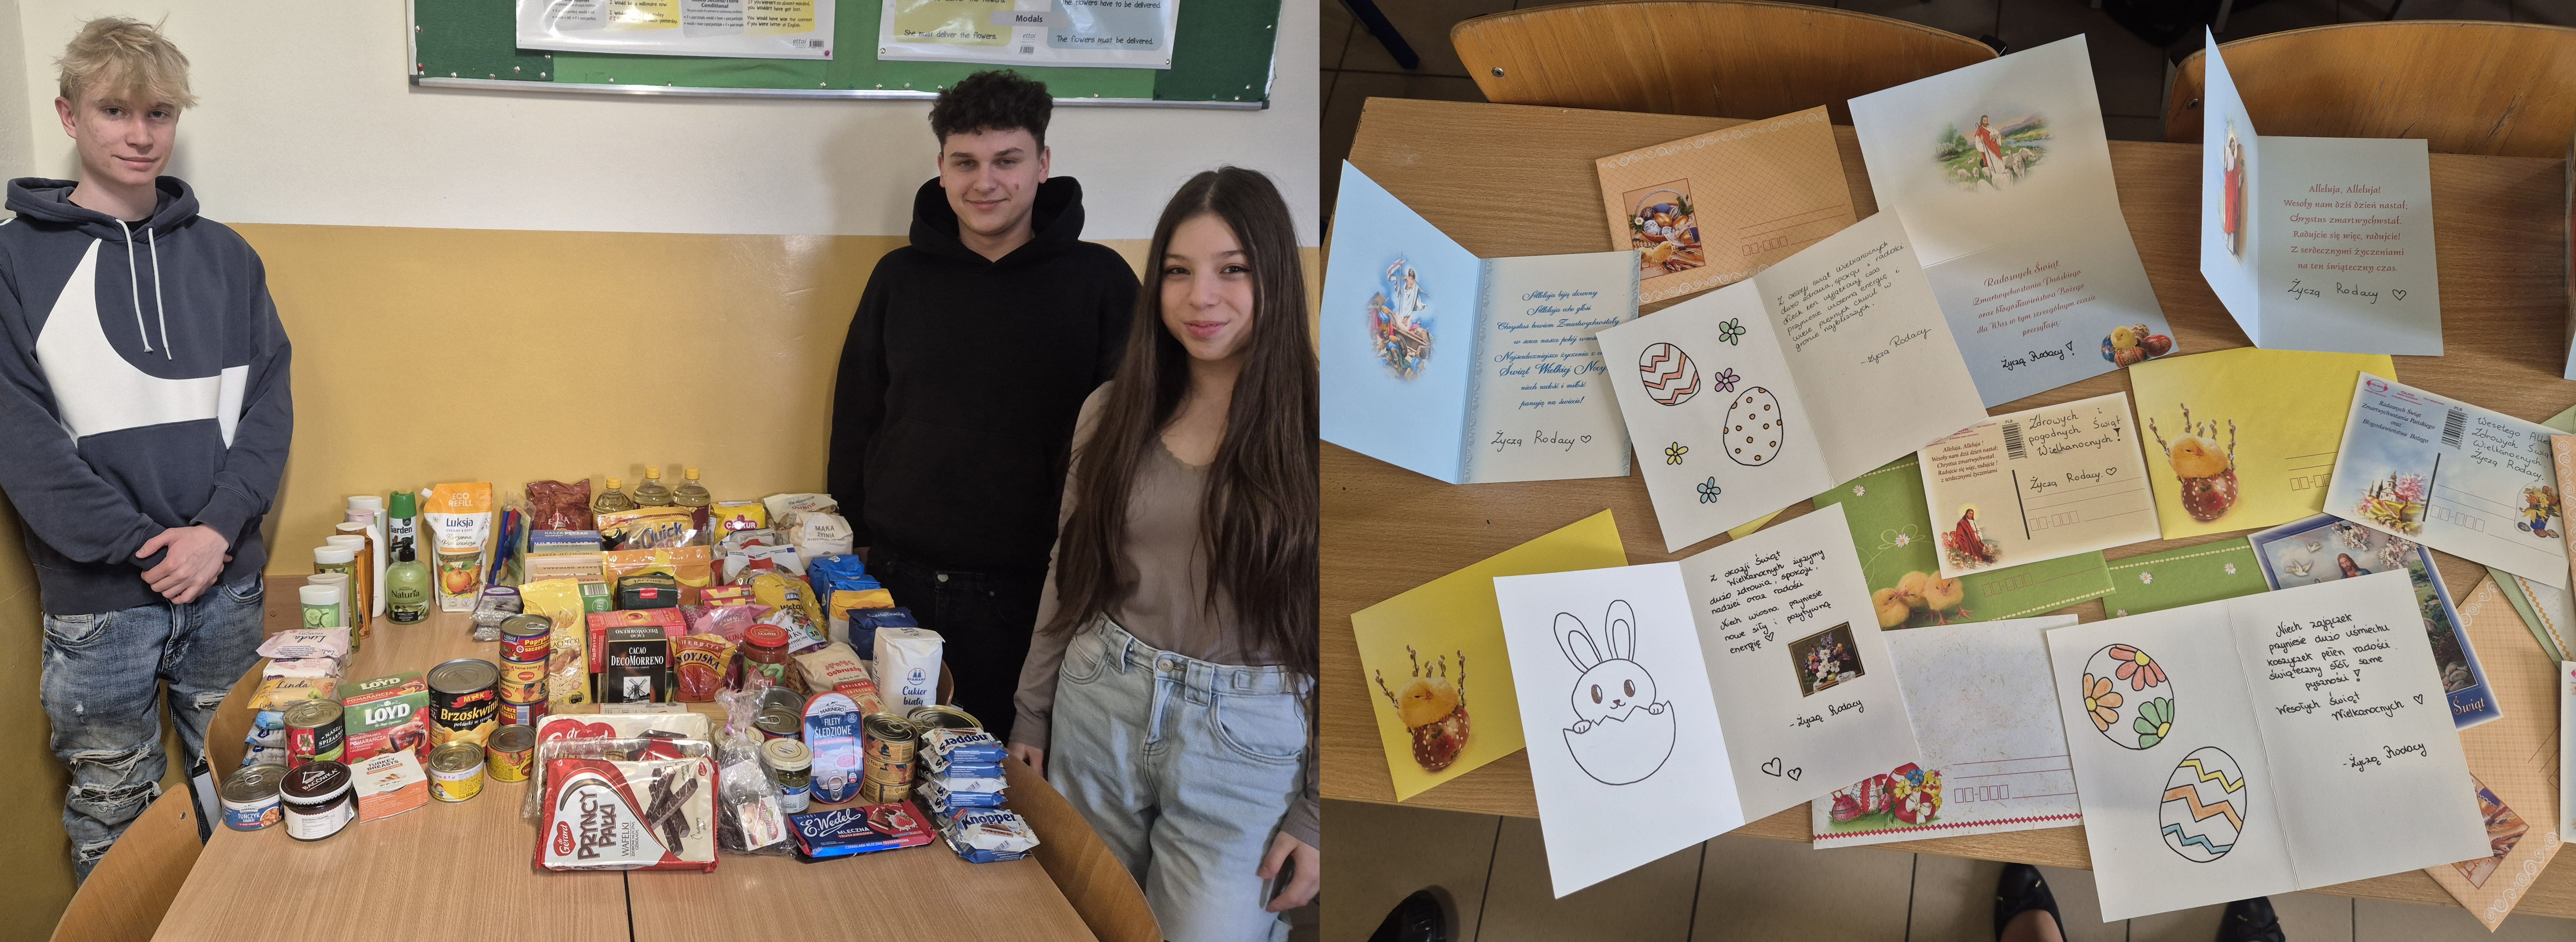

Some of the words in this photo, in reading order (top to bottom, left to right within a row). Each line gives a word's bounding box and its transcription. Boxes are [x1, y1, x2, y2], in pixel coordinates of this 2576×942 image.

[1016, 14, 1043, 23] Modals
[973, 32, 997, 40] flowers.
[2309, 183, 2342, 195] Alleluja,
[2347, 184, 2381, 195] Alleluja!
[2283, 198, 2312, 209] Wesoły
[2354, 201, 2376, 209] dzień
[2380, 200, 2408, 210] nastał;
[2290, 214, 2326, 225] Chrystus
[2329, 216, 2402, 226] zmartwychwstał.
[2293, 230, 2327, 240] Radujcie
[2330, 231, 2340, 241] się
[2343, 232, 2363, 241] więc,
[2366, 232, 2400, 242] radujcie!
[2301, 246, 2352, 256] serdecznymi
[2355, 247, 2404, 257] życzeniami
[1984, 267, 2032, 287] Radosnych
[2035, 260, 2061, 273] Świąt
[2327, 262, 2374, 273] świąteczny
[1973, 282, 2042, 306] Zmartwychwstania
[2043, 270, 2082, 286] Pańskiego
[2288, 278, 2320, 300] Życzą
[2337, 282, 2378, 304] Rodacy
[1978, 310, 1995, 319] oraz
[1996, 291, 2056, 314] błogosławieństwa
[2057, 283, 2085, 295] Bożego
[1977, 325, 1988, 334] dla
[1989, 321, 2008, 330] Was
[2018, 314, 2031, 323] tym
[2033, 301, 2076, 318] szczególnym
[2077, 295, 2097, 305] czasie
[2022, 320, 2061, 337] przesyłają:
[2001, 356, 2027, 371] Życzą
[2030, 410, 2078, 429] Zdrowych
[2029, 427, 2081, 446] pogodnych
[2093, 417, 2121, 429] Świąt
[2030, 476, 2057, 492] Życzą
[391, 525, 412, 533] Garden
[447, 517, 473, 528] Luksja
[641, 522, 683, 549] Quick
[392, 589, 420, 598] Naturia
[2276, 621, 2303, 637] Niech
[2310, 613, 2353, 629] zajączek
[293, 635, 327, 643] Linda
[682, 639, 719, 651] HERBATA
[2268, 636, 2307, 655] przyniesie
[2315, 632, 2340, 643] dużo
[2346, 623, 2390, 638] uśmiechu
[2267, 652, 2313, 670] koszyczek
[2321, 647, 2346, 661] pełen
[2353, 640, 2390, 652] radości
[2269, 664, 2323, 680] świąteczny
[2330, 659, 2350, 670] stół
[2359, 656, 2383, 665] same
[276, 680, 310, 689] Linda
[361, 677, 401, 690] LOYD
[902, 686, 927, 695] Cukier
[346, 691, 394, 703] POMARAŃCZA
[903, 696, 923, 706] biały
[2276, 699, 2321, 715] Wesołych
[2331, 701, 2404, 721] Wielkanocnych
[2453, 696, 2485, 715] Świąt
[365, 703, 411, 725] LOYD
[824, 717, 840, 726] FILETY
[325, 726, 340, 738] NASZA
[350, 732, 381, 741] ROZGRZEWAJĄCA
[815, 725, 851, 738] ŚLEDZIOWE
[350, 735, 386, 746] POMARAŃCZA
[939, 734, 992, 753] noppers
[2383, 743, 2427, 758] Rodacy
[367, 760, 399, 771] BREASTS
[368, 757, 395, 767] TURKEY
[302, 769, 337, 790] BACÓWKA
[761, 806, 769, 824] Apple
[577, 790, 600, 860] PRYNCY
[598, 804, 617, 848] PAŁKI
[559, 824, 570, 856] Gerard
